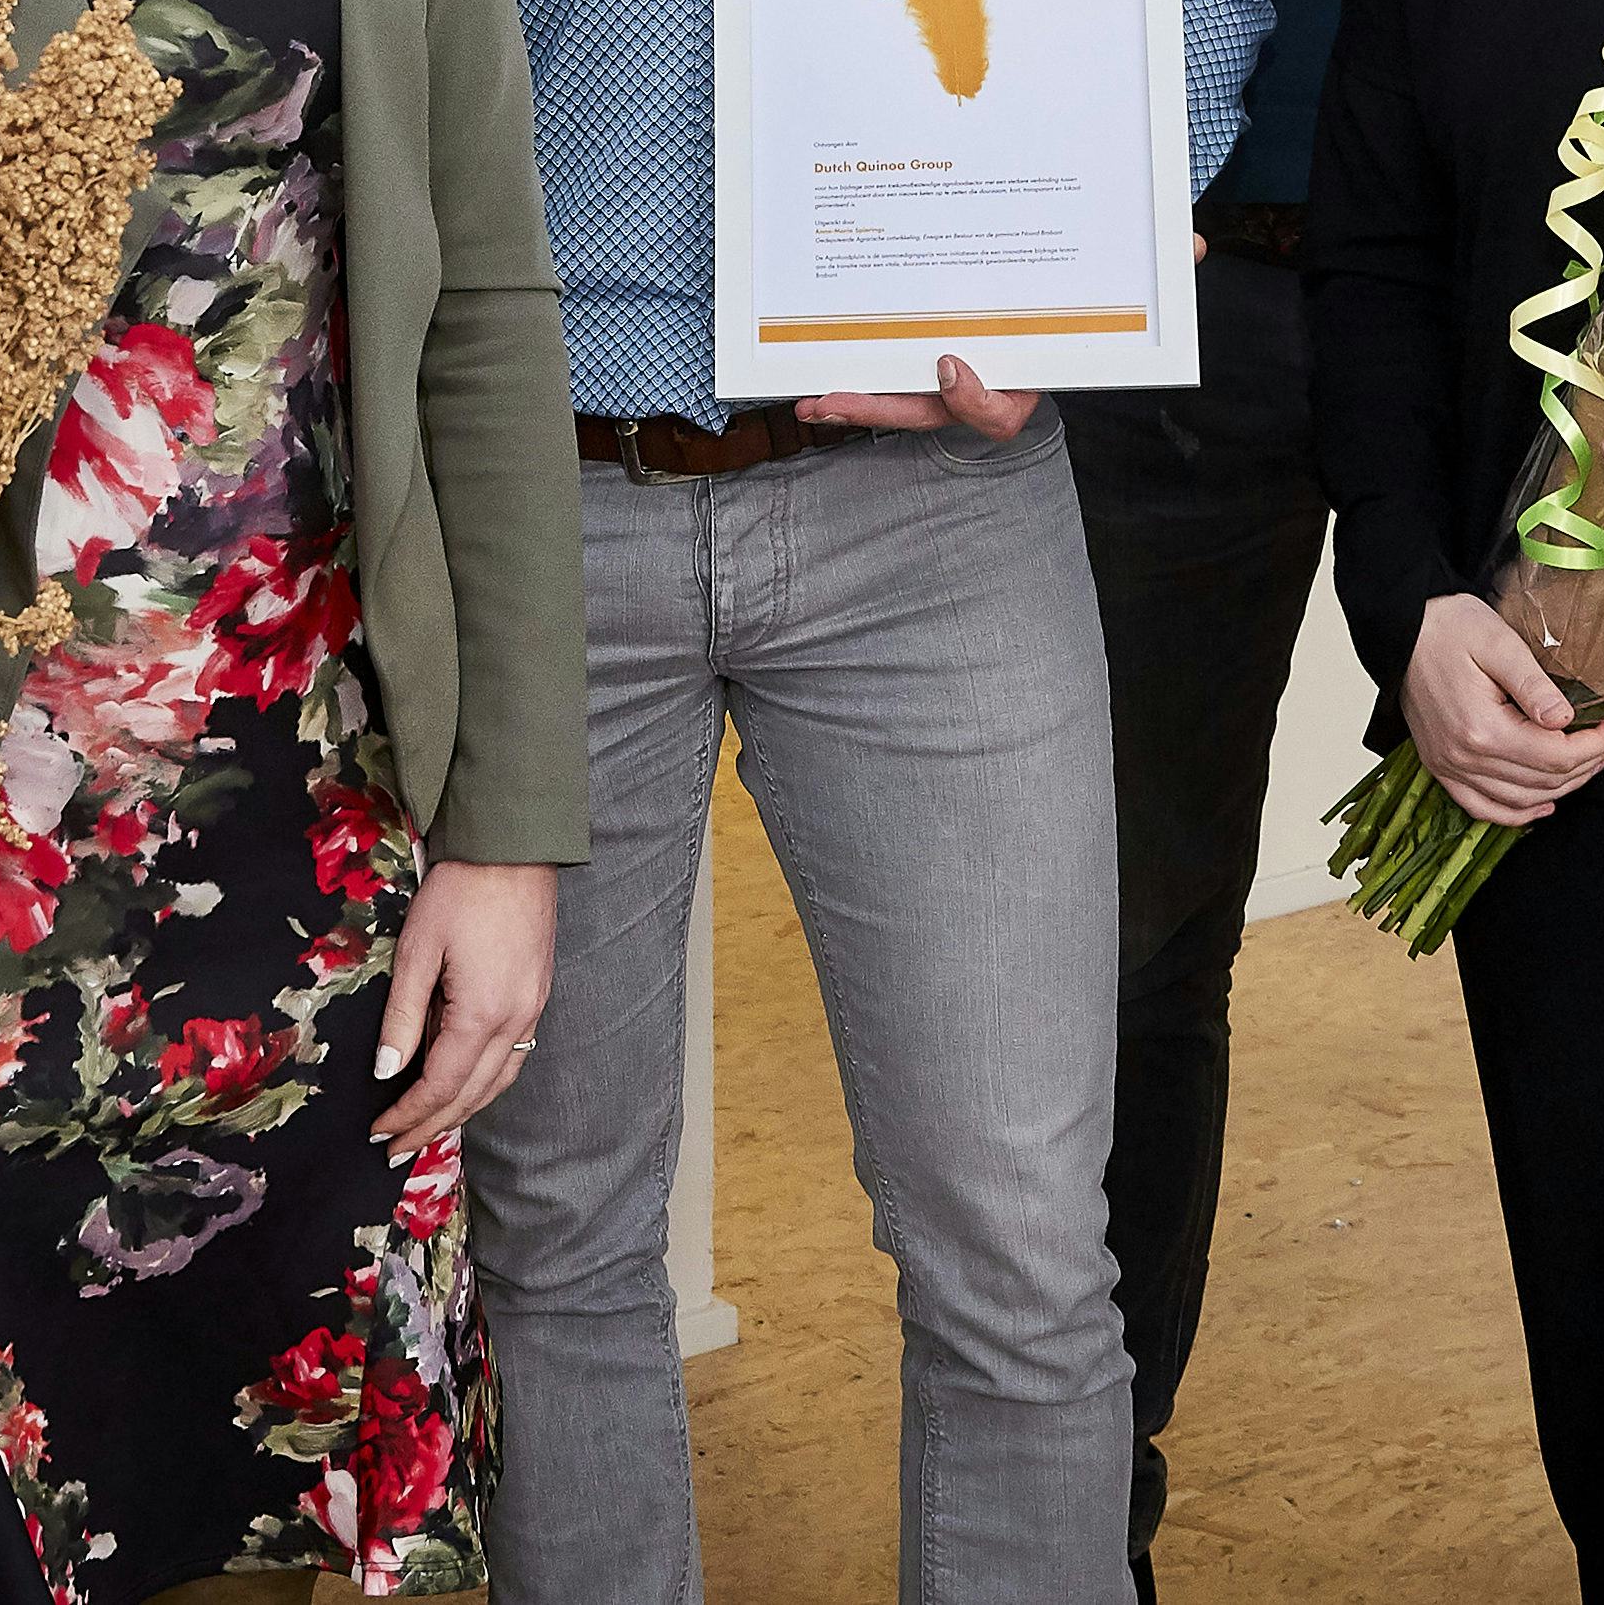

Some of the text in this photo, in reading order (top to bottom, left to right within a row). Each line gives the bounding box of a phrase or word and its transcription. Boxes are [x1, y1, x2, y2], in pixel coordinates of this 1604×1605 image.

[814, 159, 953, 173] Dutch Quinoa Group
